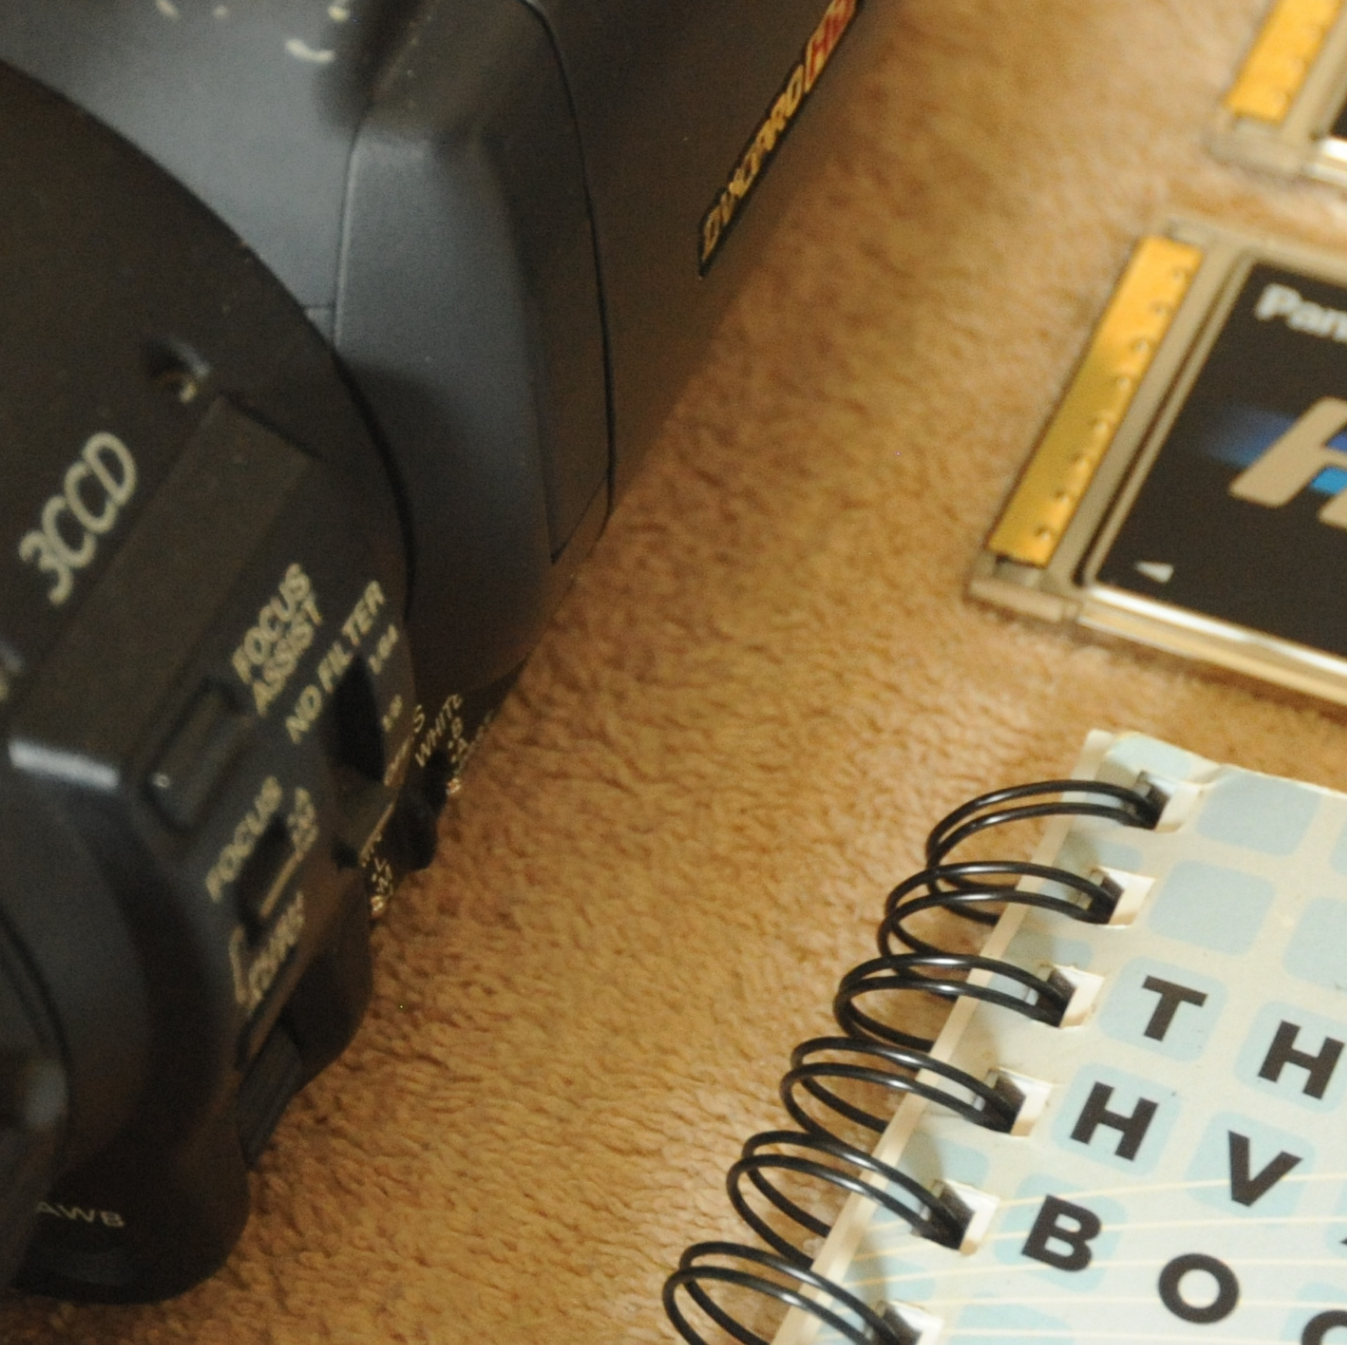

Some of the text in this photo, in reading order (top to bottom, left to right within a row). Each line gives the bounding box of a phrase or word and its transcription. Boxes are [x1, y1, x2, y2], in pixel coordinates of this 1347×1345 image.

[18, 432, 136, 606] 3CCD
[232, 563, 310, 685] FOCUS
[37, 1201, 125, 1227] AWB
